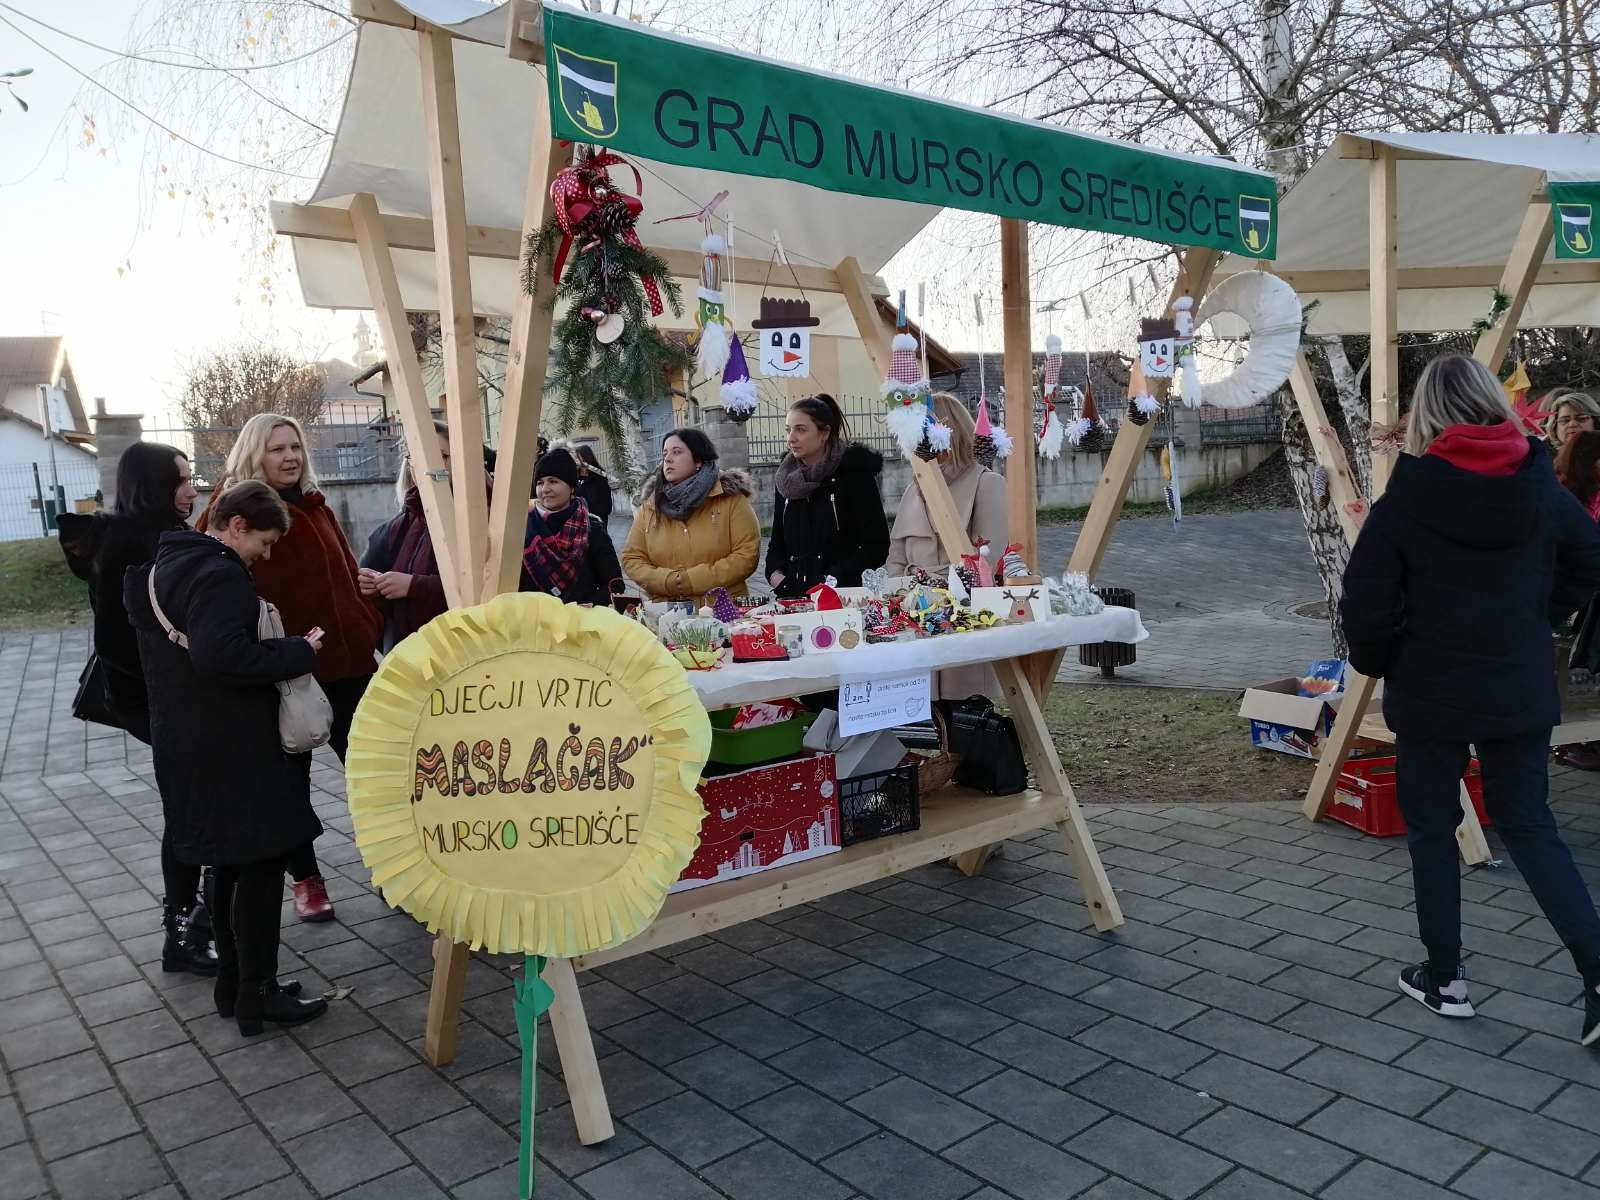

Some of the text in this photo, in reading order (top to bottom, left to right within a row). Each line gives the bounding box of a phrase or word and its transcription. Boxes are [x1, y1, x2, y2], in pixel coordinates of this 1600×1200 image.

[653, 88, 1234, 239] GRAD MURSKO SREDIŠĆE
[430, 674, 524, 717] DJEČJI
[423, 805, 639, 854] MURSKO SREDIŠĆE
